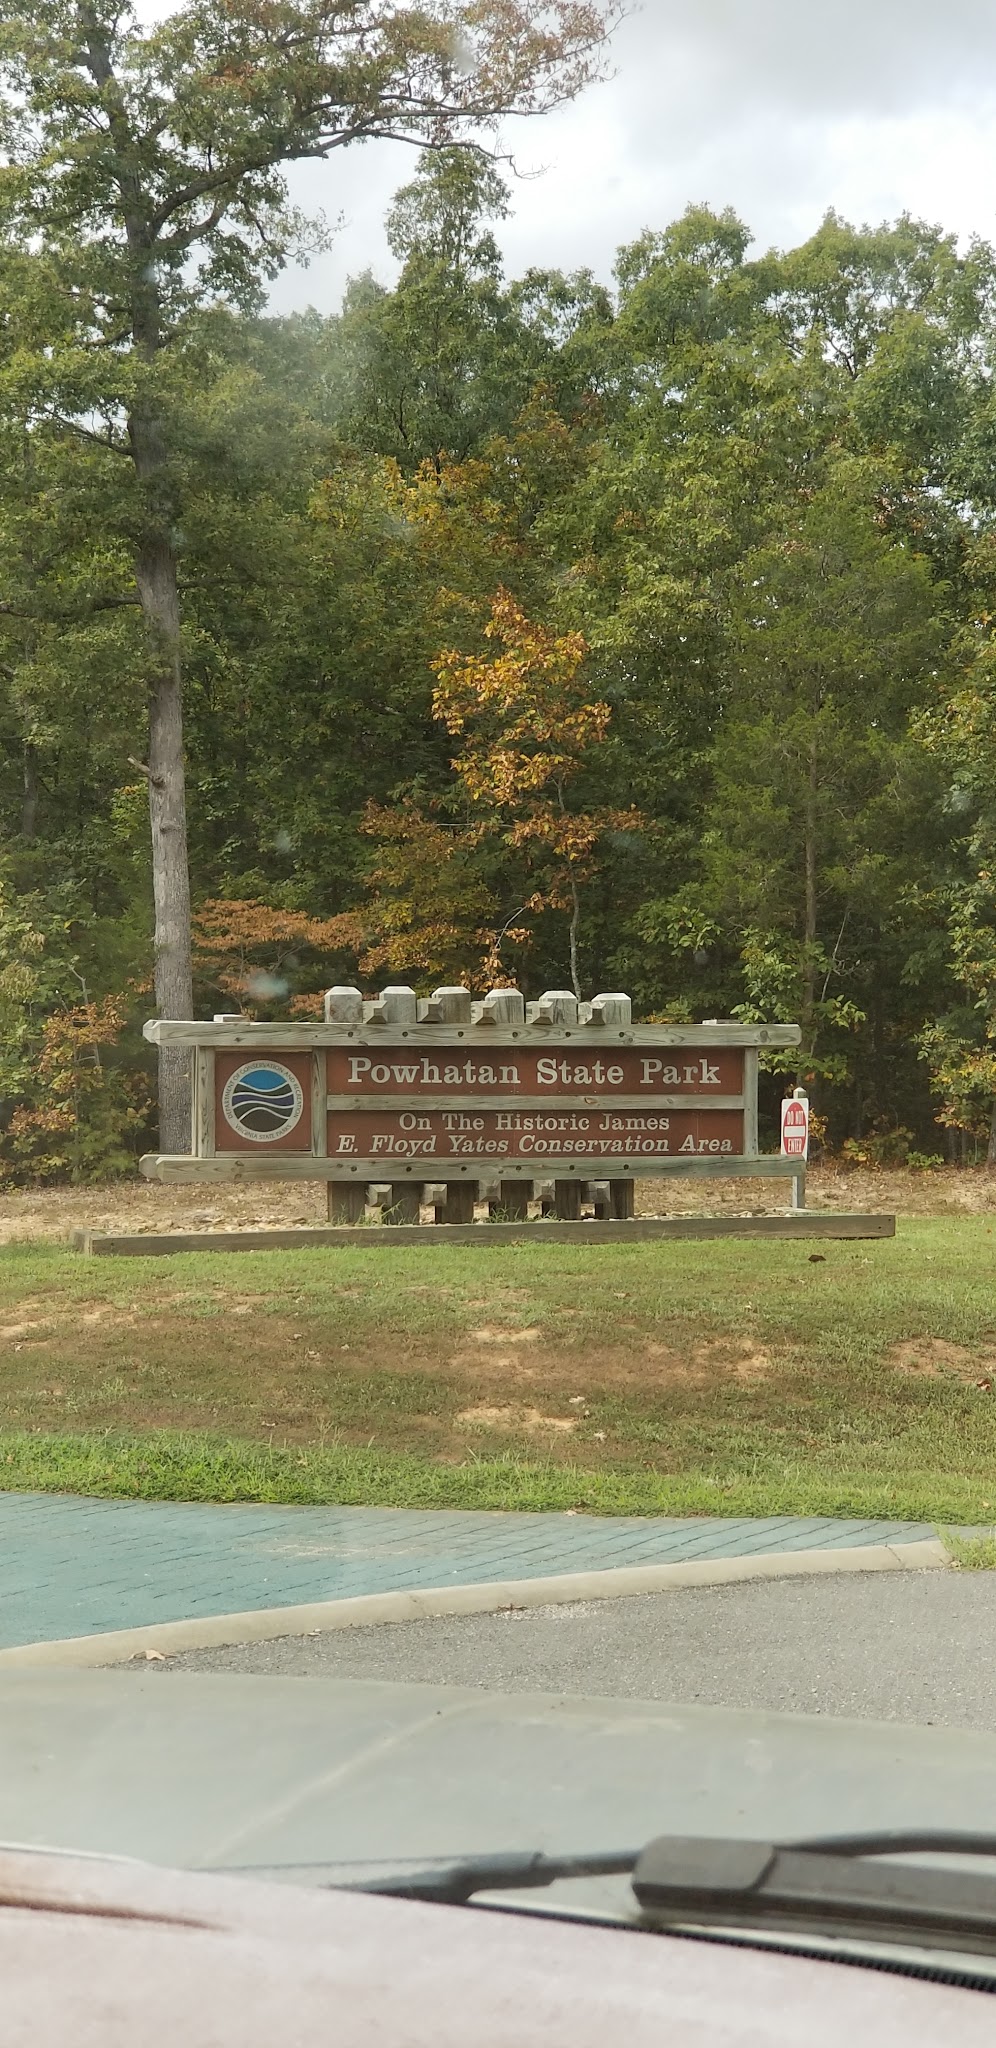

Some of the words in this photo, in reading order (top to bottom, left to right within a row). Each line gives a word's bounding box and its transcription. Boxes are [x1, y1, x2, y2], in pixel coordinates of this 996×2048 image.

[347, 1057, 521, 1084] Powhatan
[536, 1058, 625, 1084] State
[640, 1058, 721, 1084] Park
[399, 1113, 432, 1131] On
[442, 1113, 485, 1131] The
[495, 1113, 590, 1131] Historic
[598, 1113, 670, 1131] James
[786, 1110, 794, 1125] DO
[795, 1110, 804, 1125] NOT
[335, 1135, 358, 1153] E.
[369, 1135, 437, 1157] Floyd
[448, 1135, 509, 1153] Yates
[517, 1135, 670, 1153] Conservation
[678, 1135, 733, 1153] Area
[787, 1138, 803, 1153] ENTER
